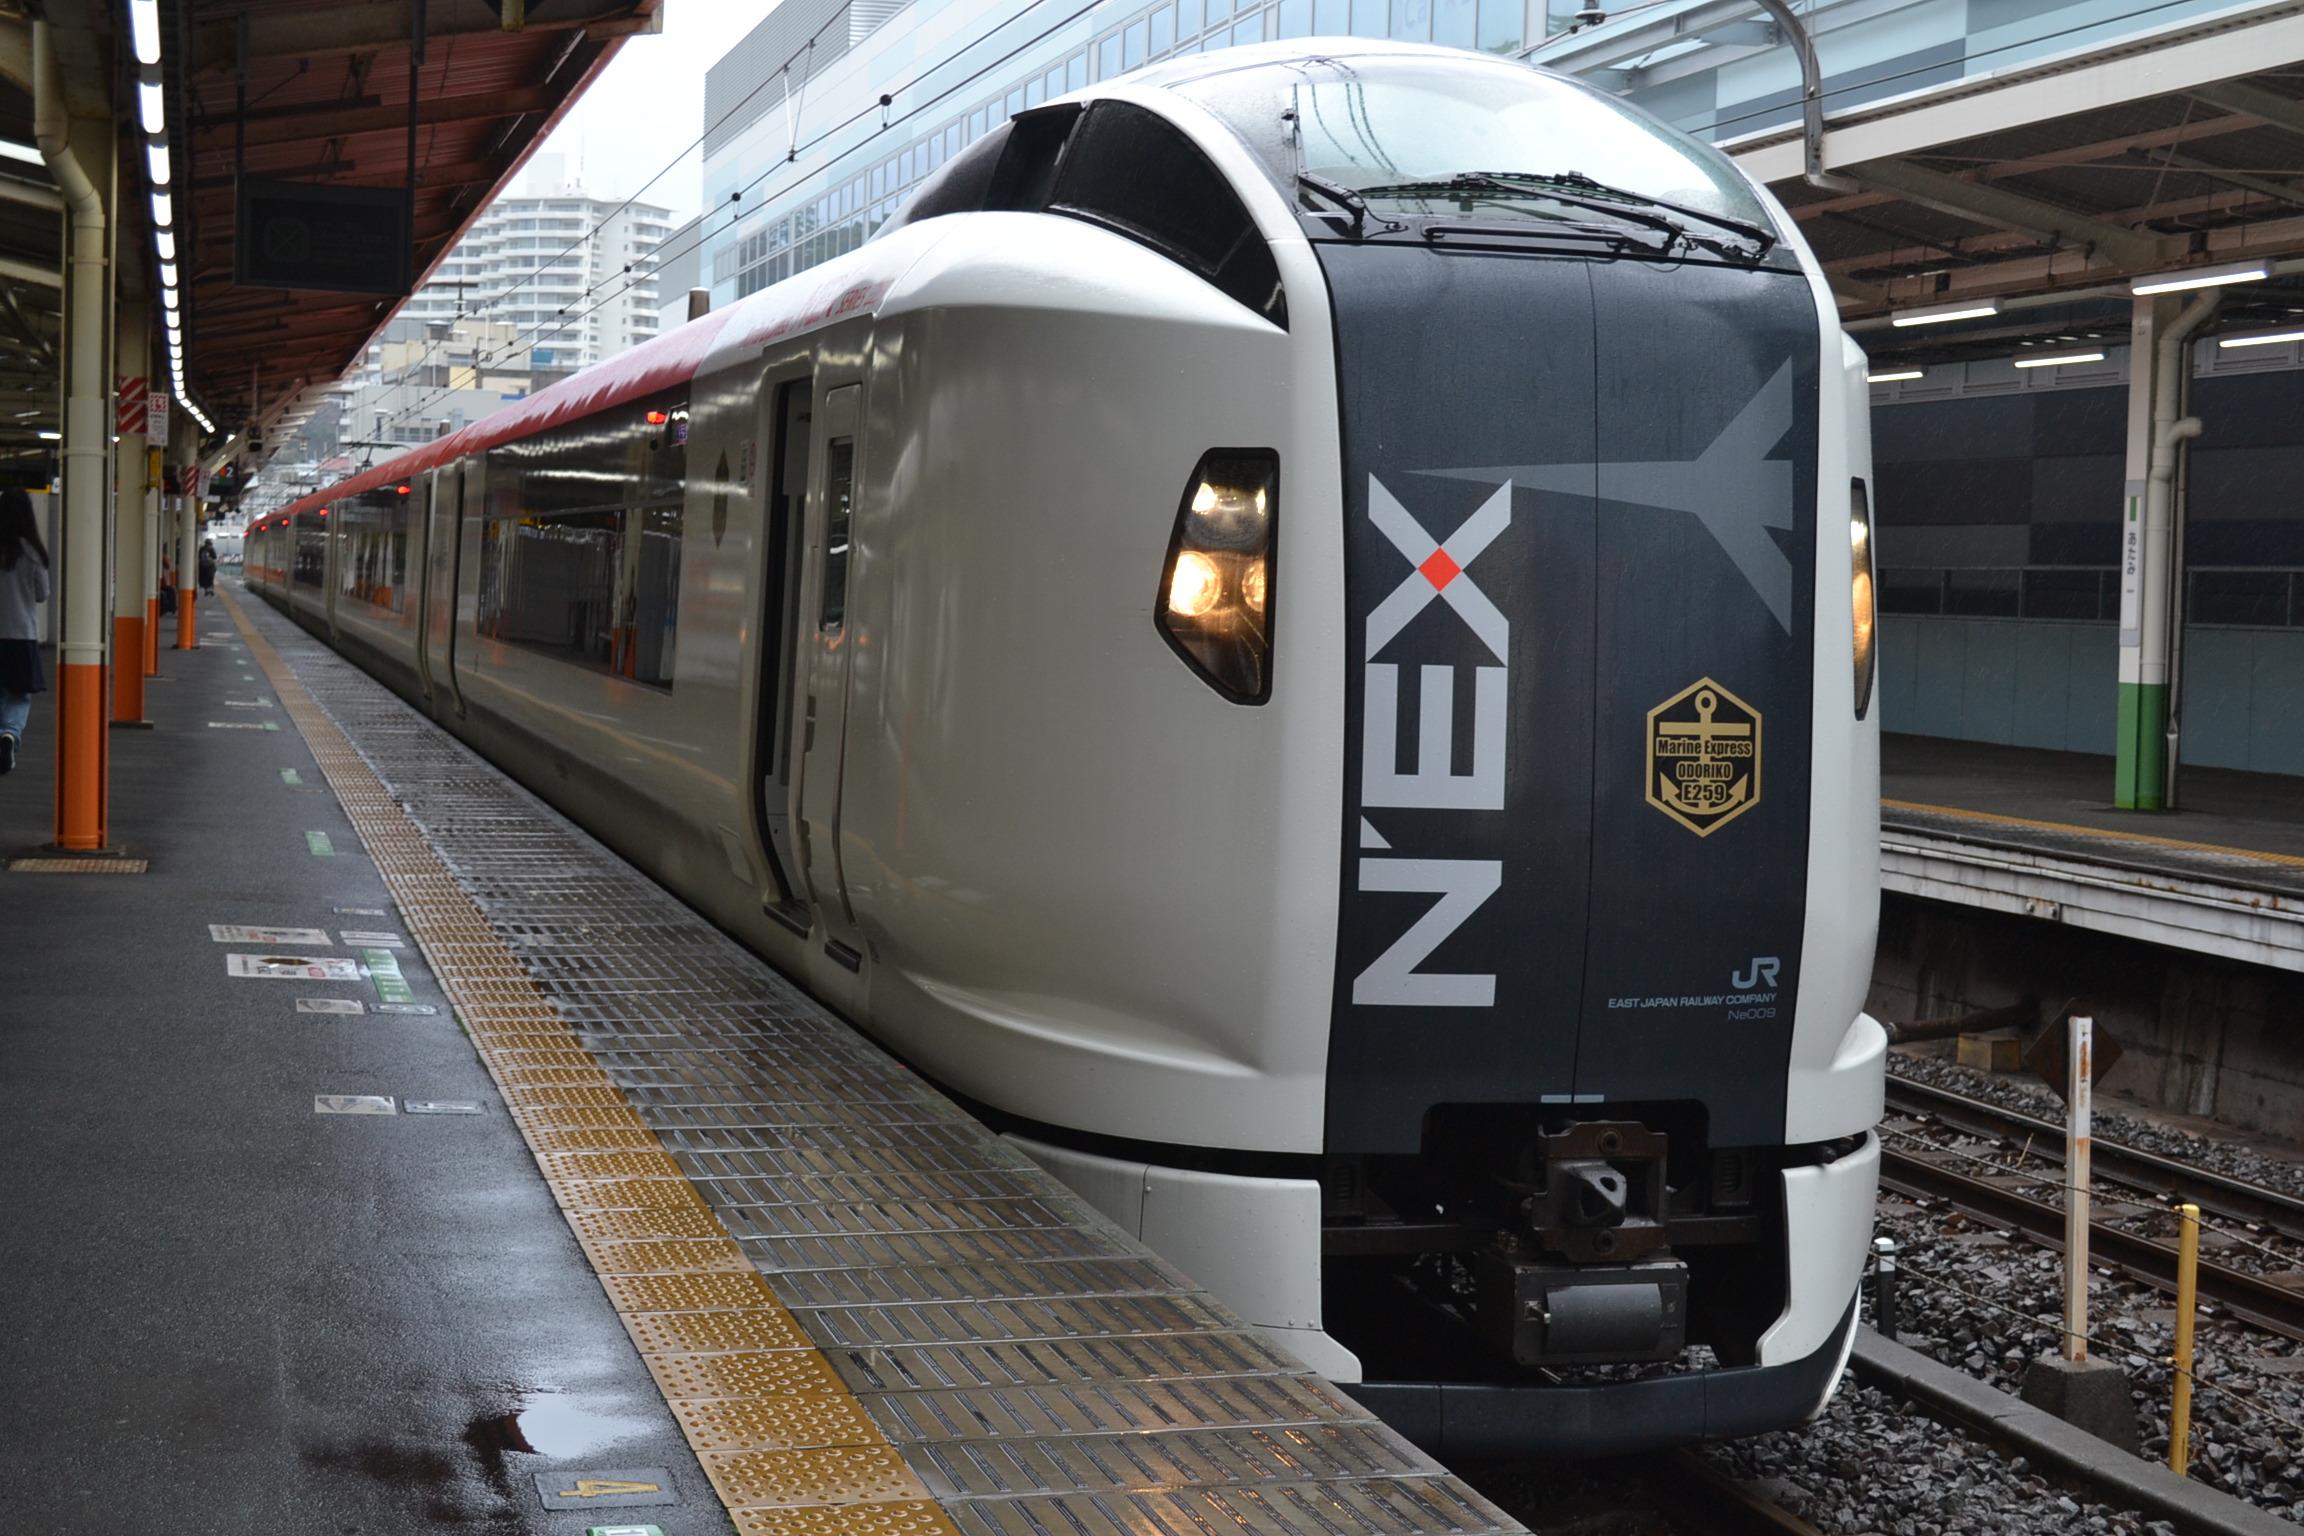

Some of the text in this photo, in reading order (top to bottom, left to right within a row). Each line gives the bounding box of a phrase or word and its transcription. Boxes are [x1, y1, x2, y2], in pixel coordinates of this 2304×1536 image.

[1657, 738, 1751, 757] Marine Express
[1677, 763, 1732, 779] ODORIKO
[1683, 784, 1725, 801] E259
[1731, 956, 1781, 990] JR
[1607, 992, 1778, 1009] EAST JAPAN RAILWAY COMPANY
[1727, 1007, 1777, 1021] Ne009
